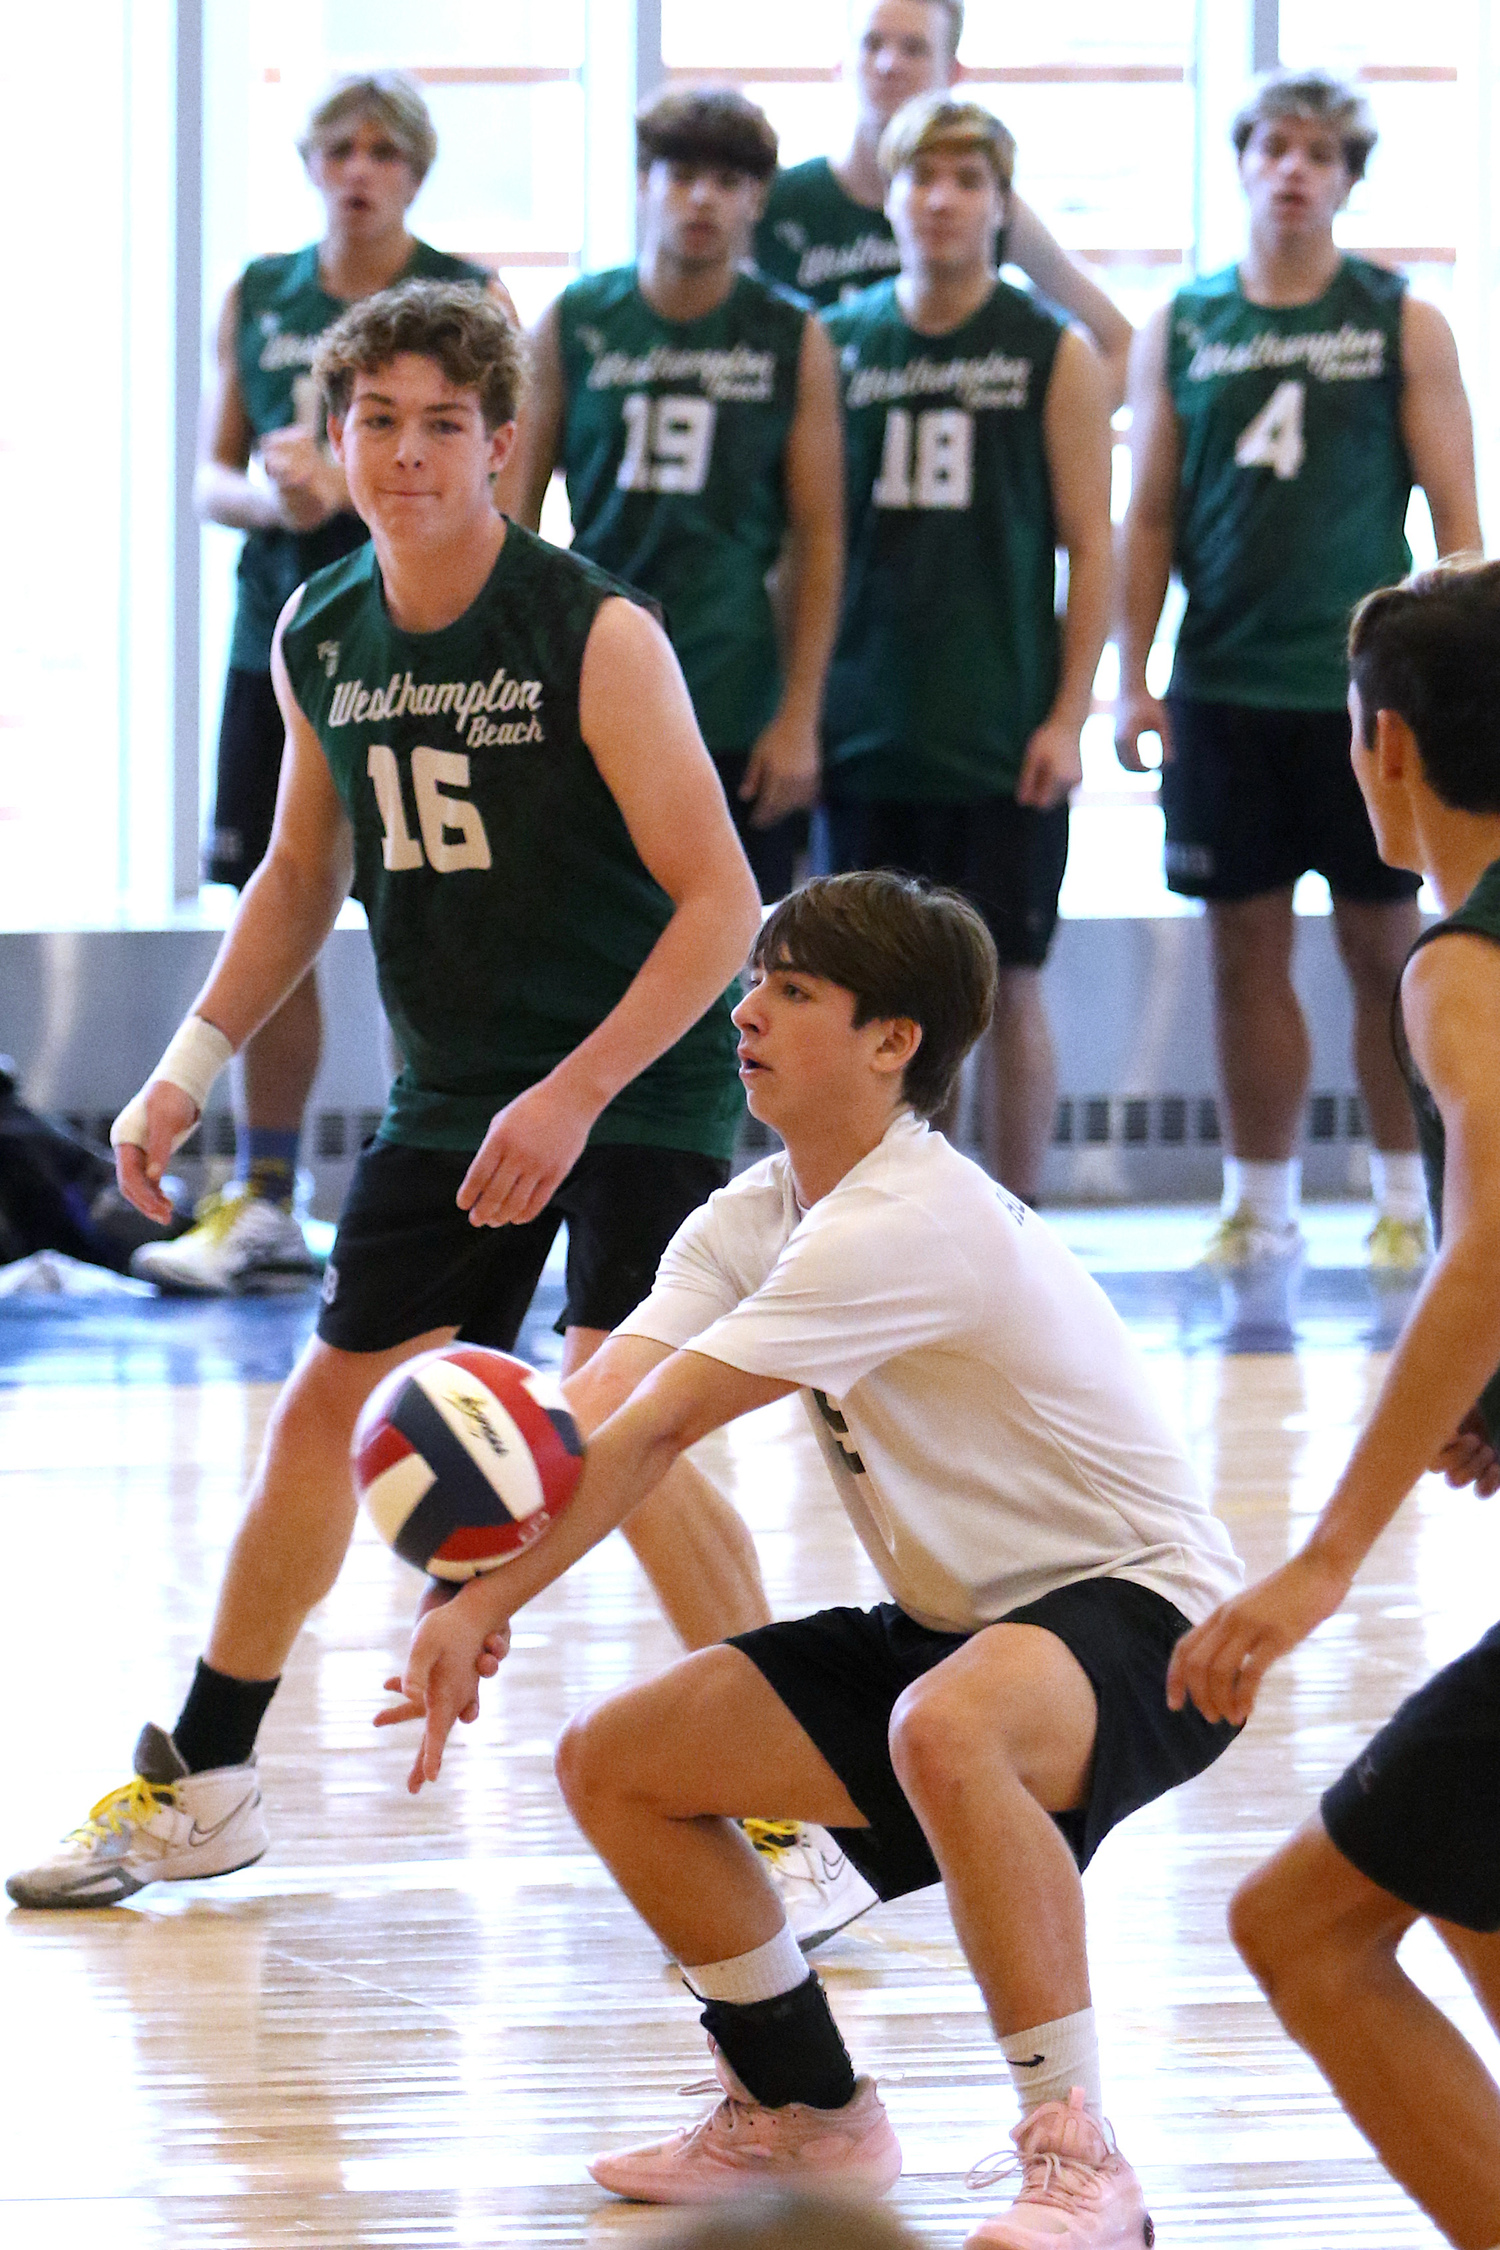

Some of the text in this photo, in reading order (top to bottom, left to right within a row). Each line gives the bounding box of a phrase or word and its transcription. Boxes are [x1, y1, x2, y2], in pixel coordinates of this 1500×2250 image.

[615, 392, 717, 495] 19
[871, 407, 976, 510] 18
[1235, 379, 1306, 481] 4
[328, 667, 545, 733] Westhampton
[466, 714, 546, 749] Beach
[366, 744, 493, 874] 16
